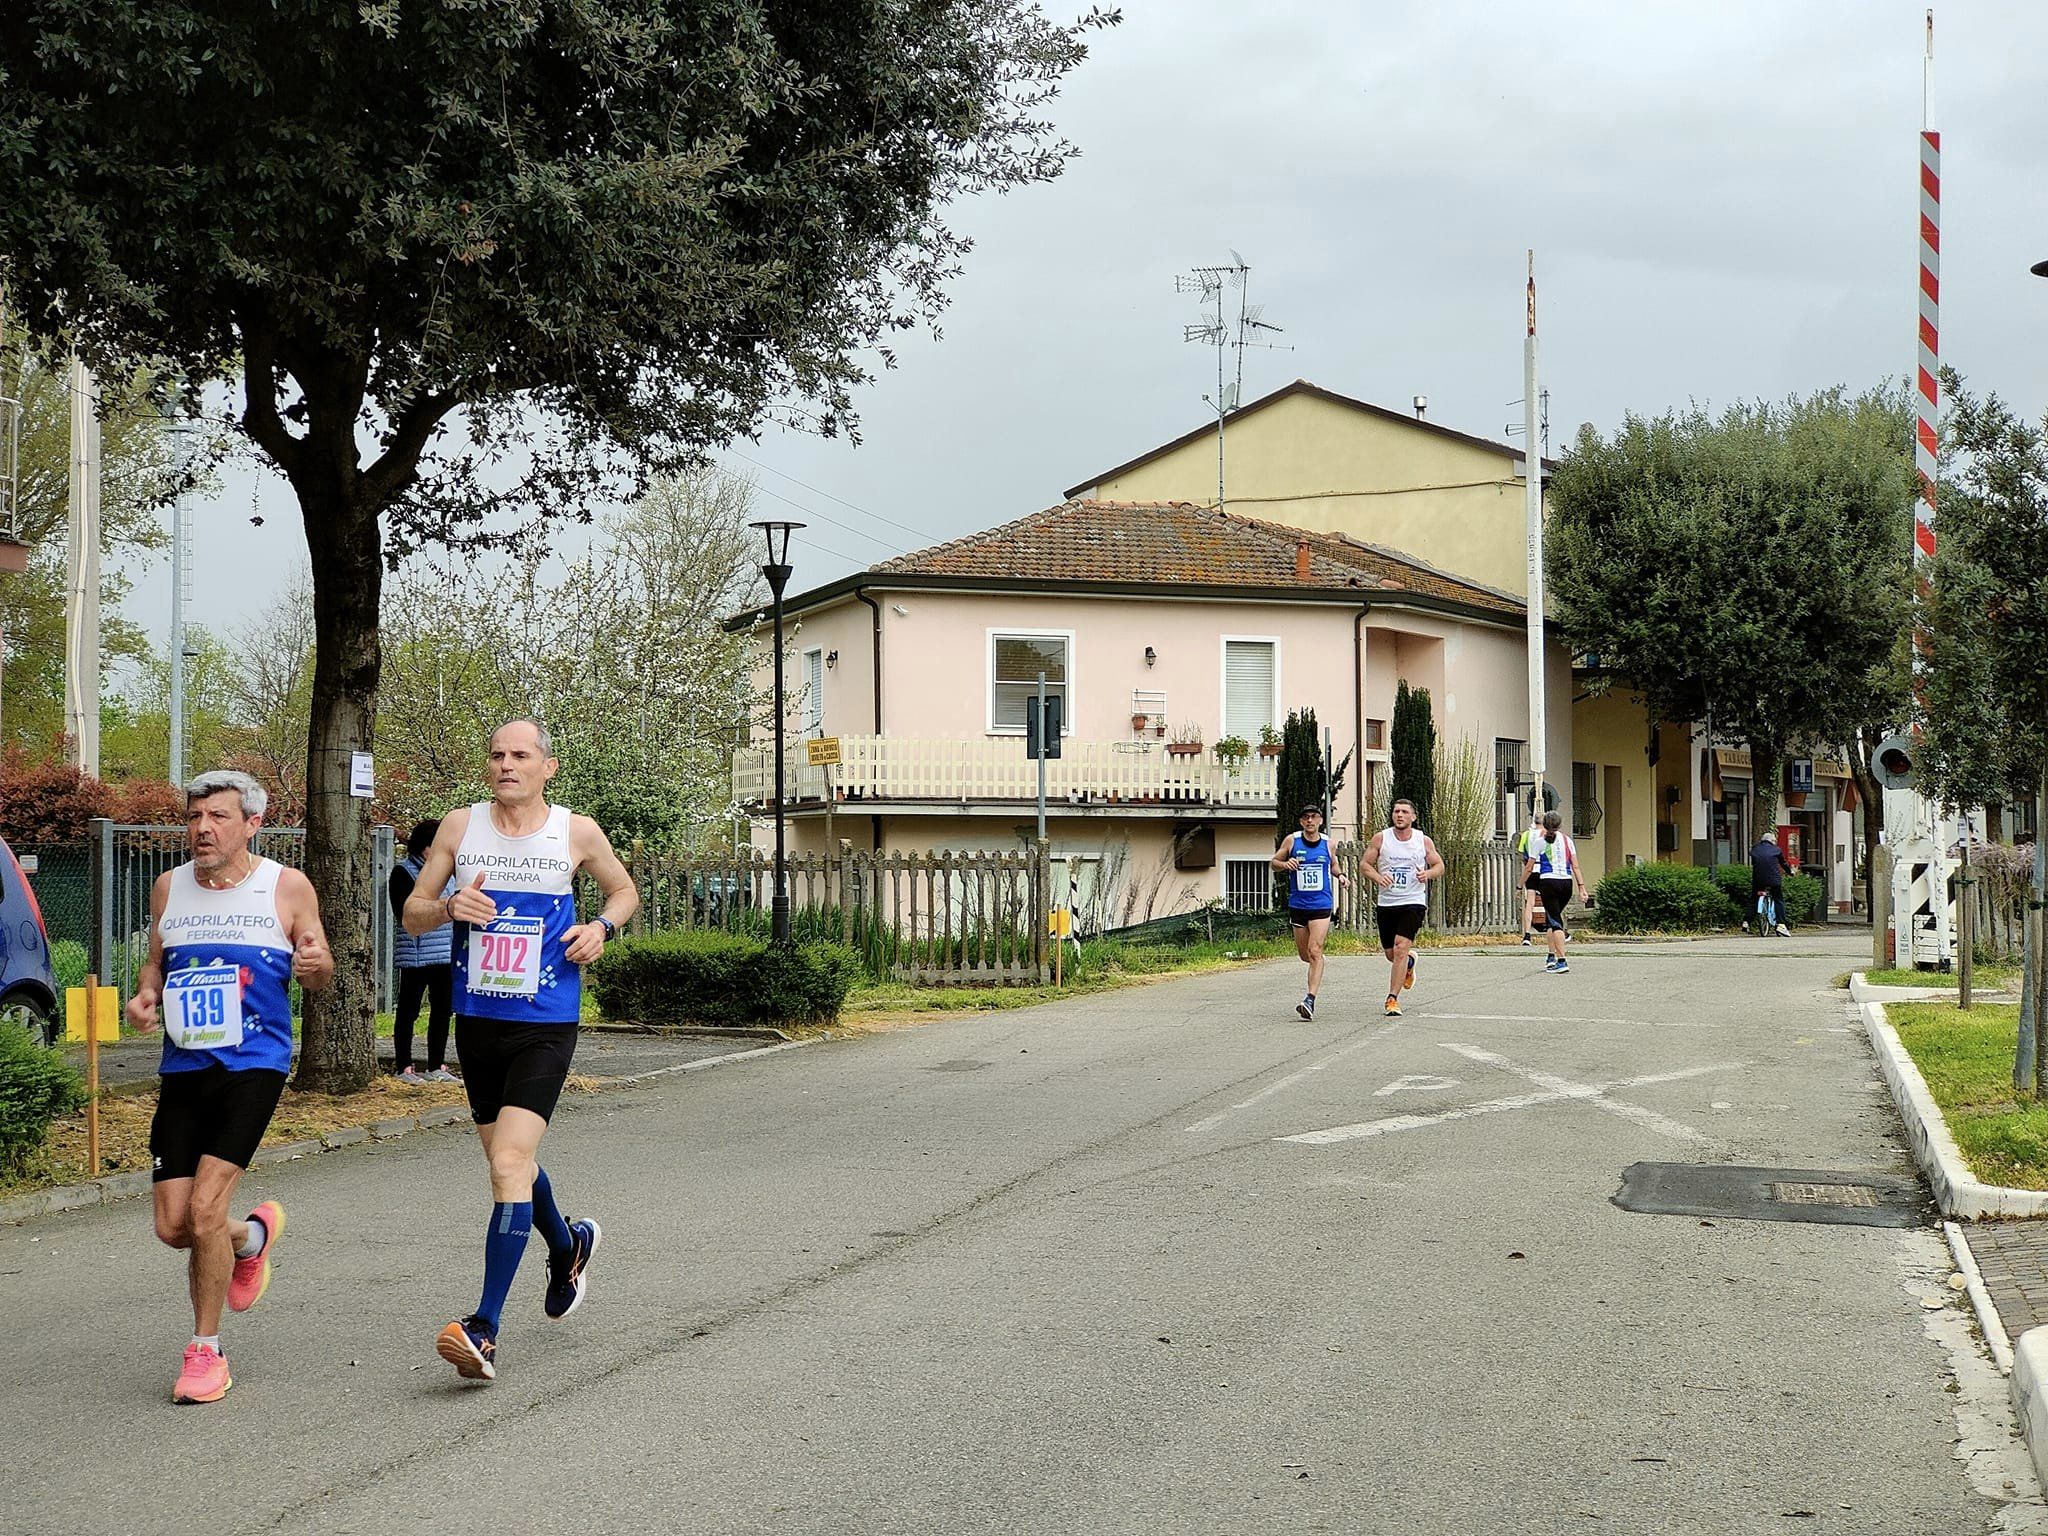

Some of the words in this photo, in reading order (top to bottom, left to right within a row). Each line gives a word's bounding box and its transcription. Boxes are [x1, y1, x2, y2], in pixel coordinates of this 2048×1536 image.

[1794, 760, 1811, 782] T
[457, 854, 570, 872] QUADRILATERO
[1303, 871, 1318, 884] 155
[1392, 872, 1407, 885] 125
[165, 915, 275, 930] QUADRILATERO
[186, 930, 246, 941] FERRARA
[481, 935, 528, 973] 202
[179, 988, 225, 1028] 139
